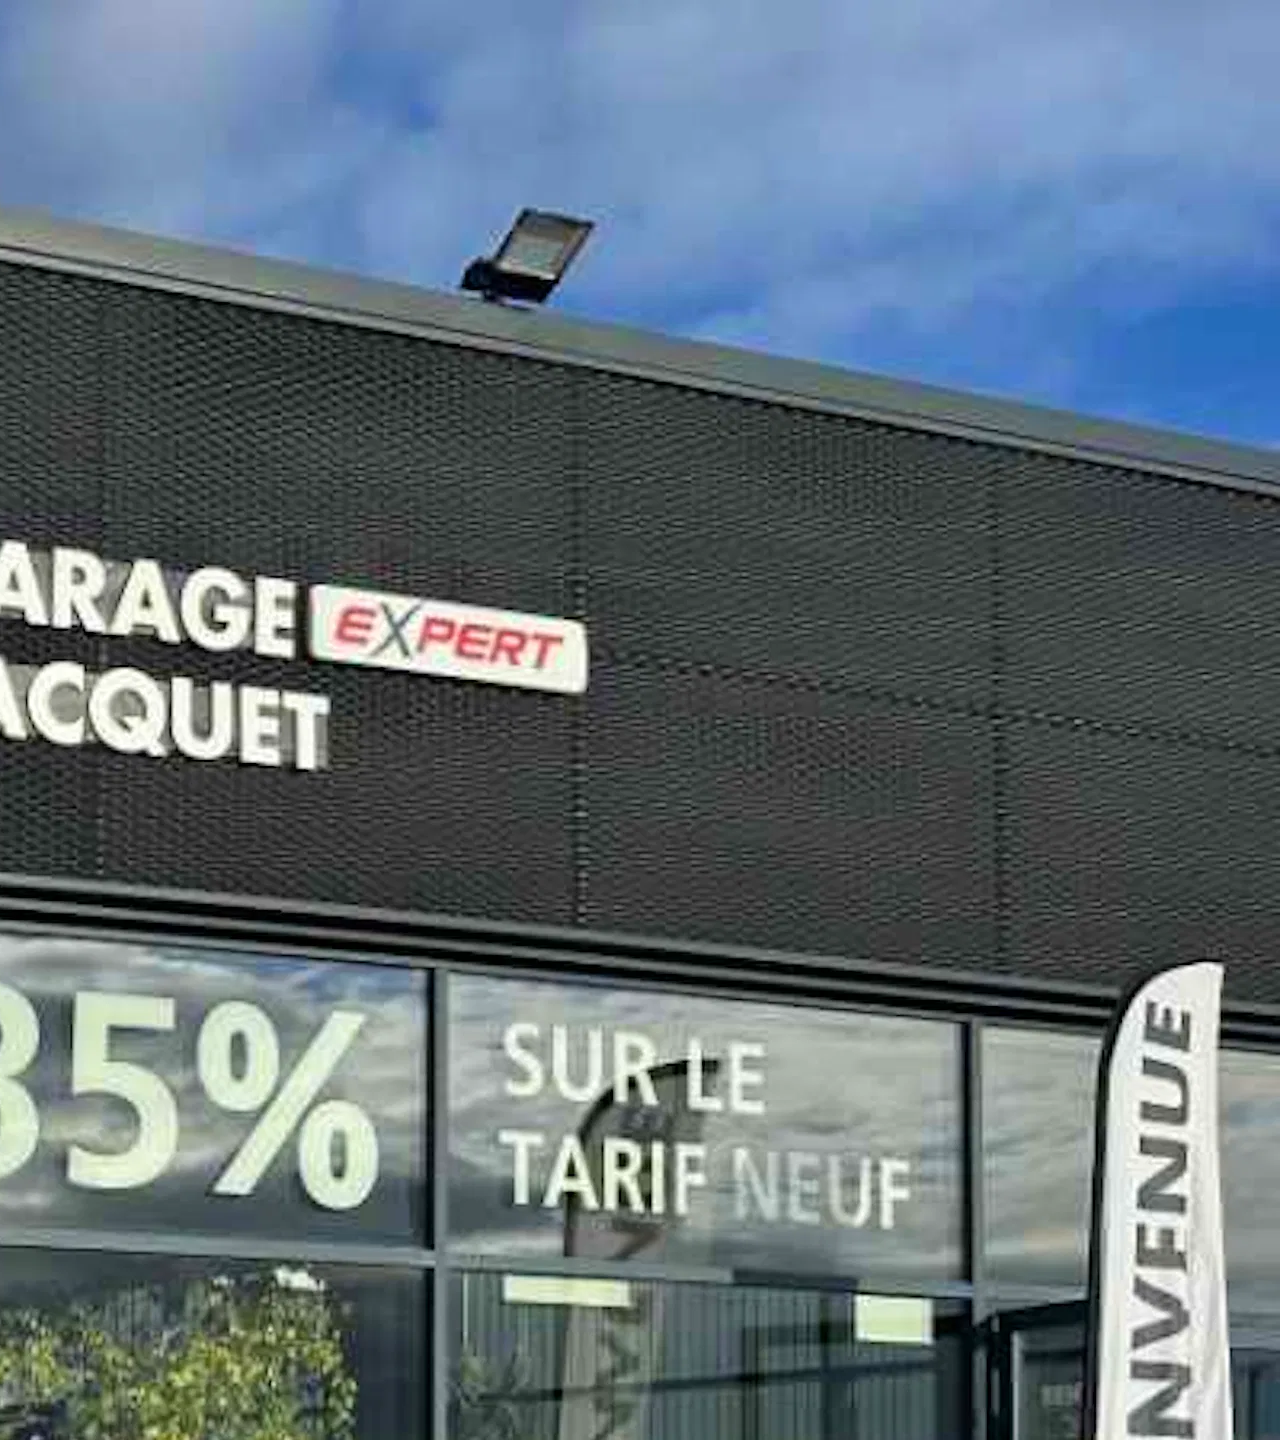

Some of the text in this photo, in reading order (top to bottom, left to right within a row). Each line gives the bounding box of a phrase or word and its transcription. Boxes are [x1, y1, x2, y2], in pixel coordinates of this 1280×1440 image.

[502, 1022, 767, 1115] SUR LE
[498, 1128, 911, 1230] TARIF NEUF
